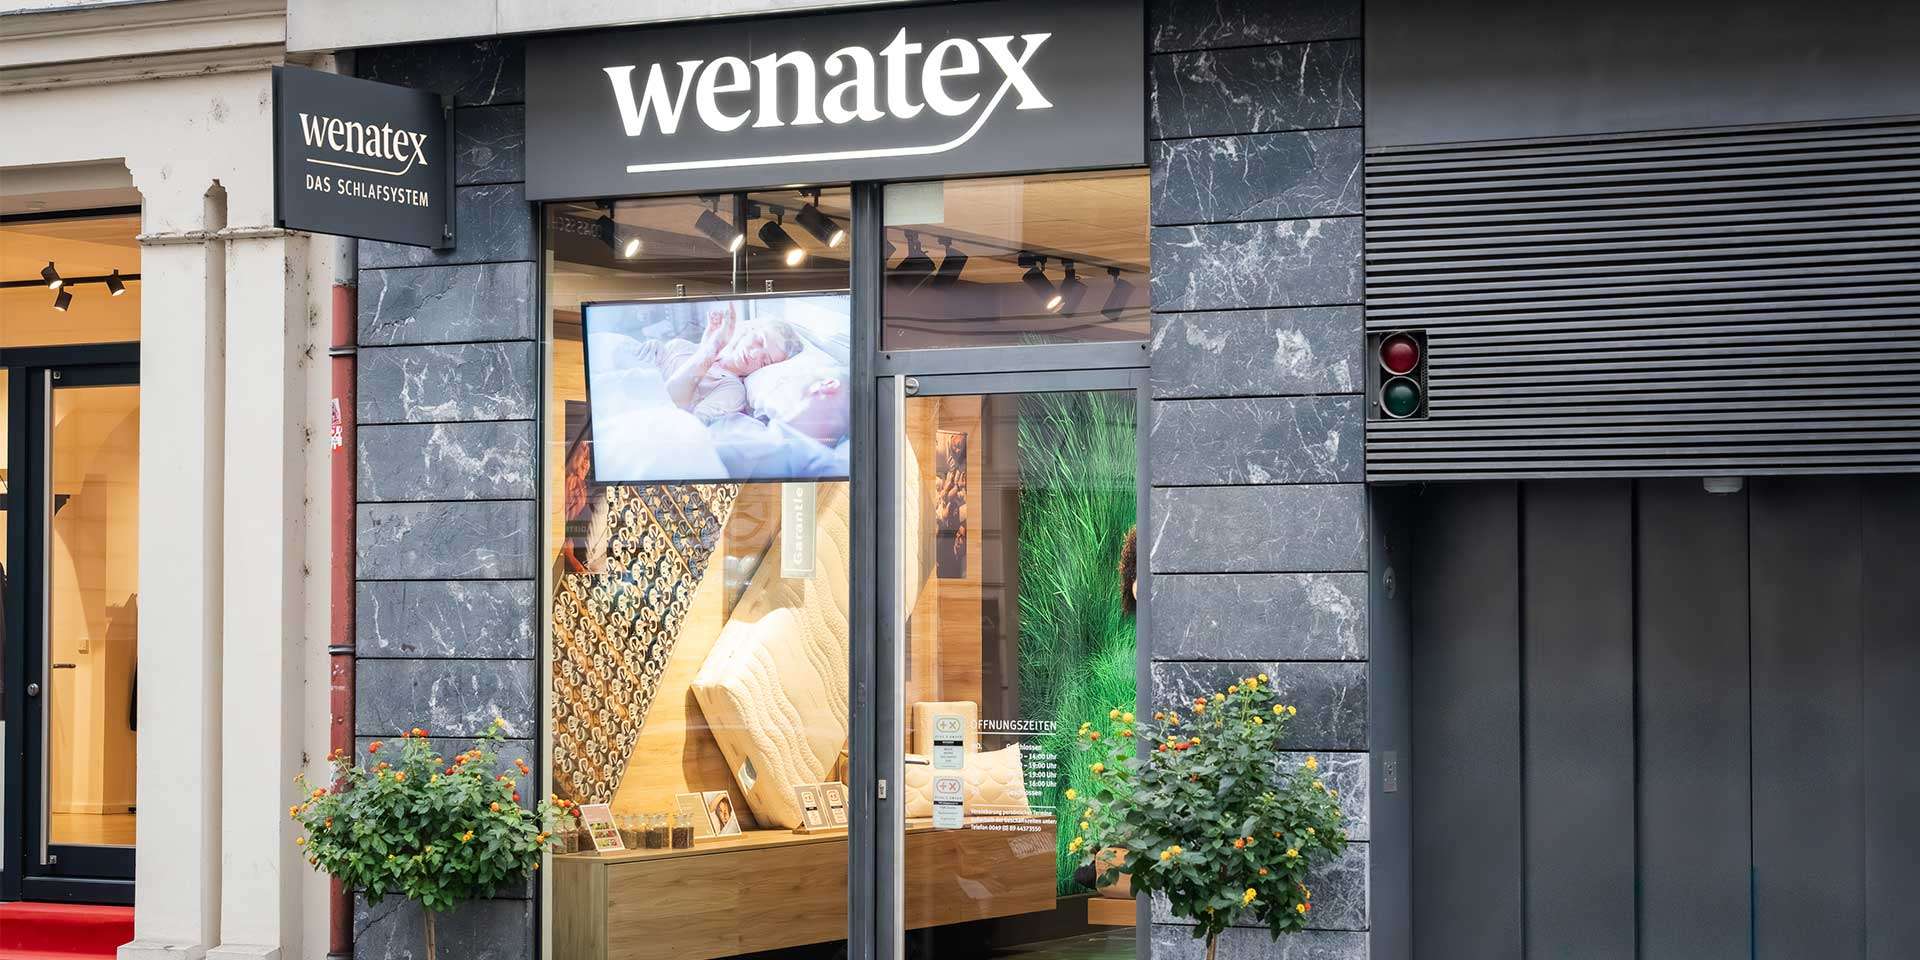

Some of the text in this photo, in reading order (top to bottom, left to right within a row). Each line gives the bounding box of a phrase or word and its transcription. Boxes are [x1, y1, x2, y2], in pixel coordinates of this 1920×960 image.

[603, 26, 1054, 137] wenatex
[299, 113, 428, 166] wenatex
[306, 174, 429, 207] DAS SCHLAFSYSTEM
